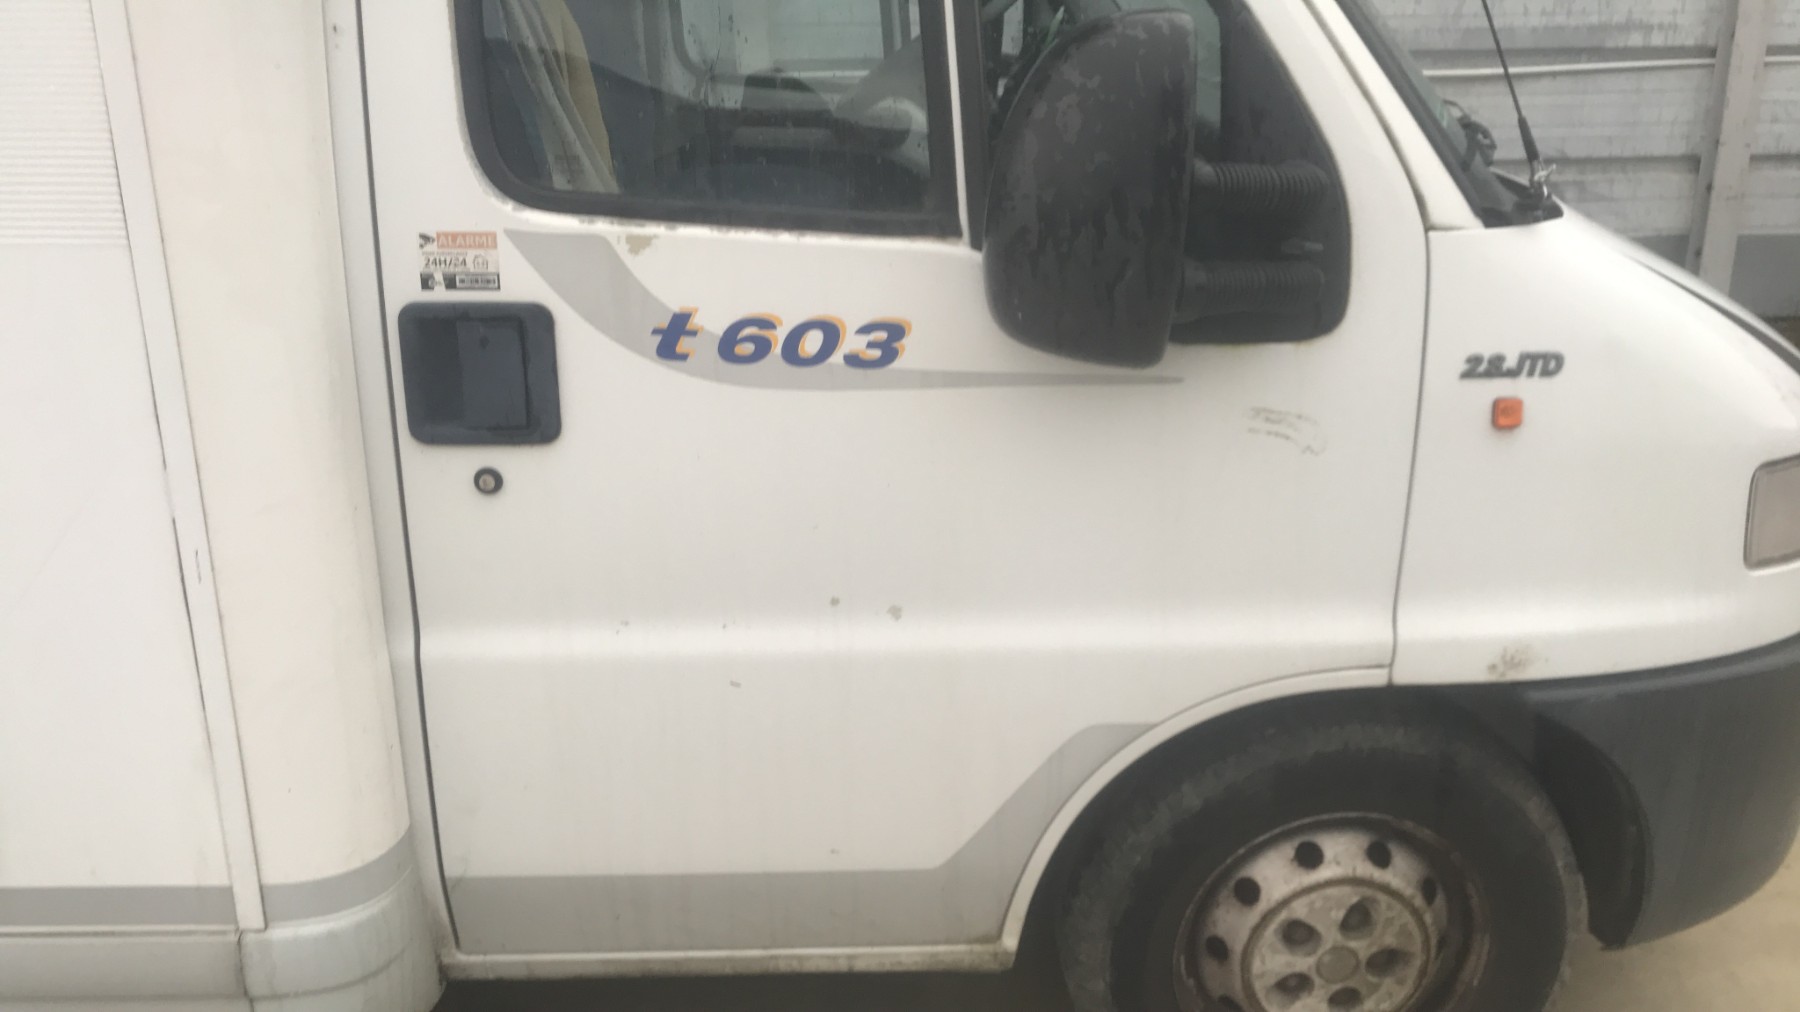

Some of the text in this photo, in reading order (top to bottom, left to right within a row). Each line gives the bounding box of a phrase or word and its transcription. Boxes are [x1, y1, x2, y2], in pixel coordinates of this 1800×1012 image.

[437, 233, 496, 248] ALARME
[651, 307, 912, 370] t 603
